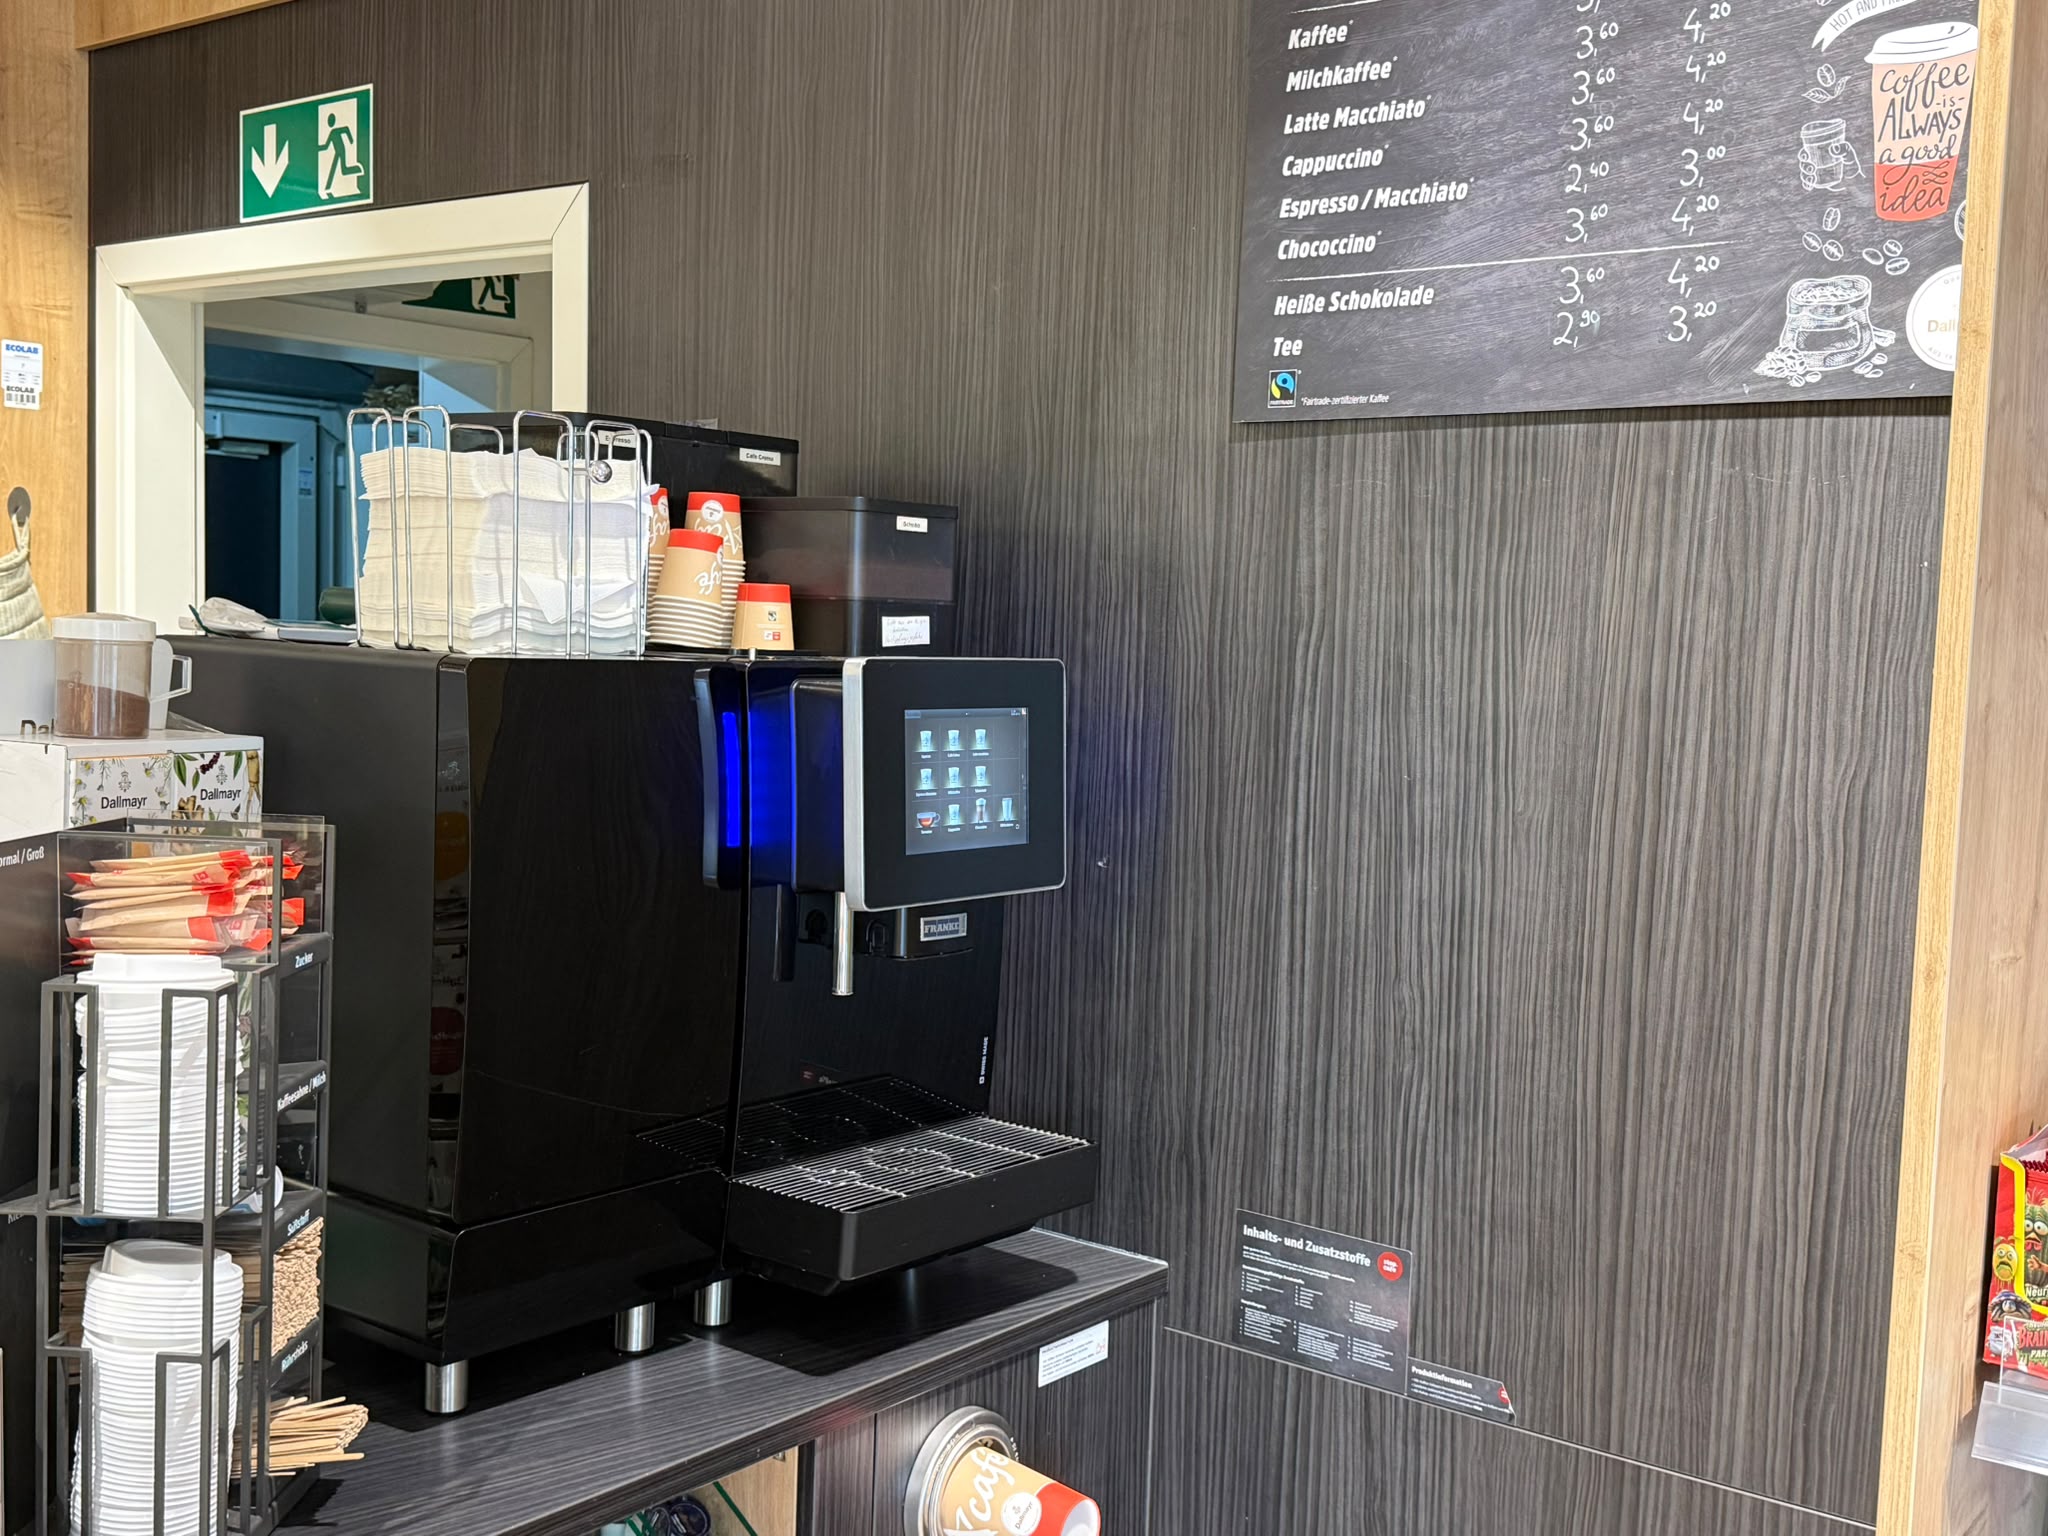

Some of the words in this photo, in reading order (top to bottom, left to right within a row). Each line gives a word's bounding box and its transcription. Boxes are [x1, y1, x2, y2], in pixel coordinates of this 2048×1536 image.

[1829, 8, 1853, 31] HOT
[1284, 112, 1329, 134] Latte
[1879, 148, 1896, 165] a
[1890, 134, 1957, 179] good
[1279, 191, 1358, 219] Espresso
[1361, 188, 1373, 211] /
[1879, 175, 1946, 214] idea
[1274, 293, 1325, 315] Heiße
[1328, 285, 1434, 312] Schokolade
[1927, 319, 1956, 333] Dall
[5, 344, 39, 354] ECOLAB
[1273, 337, 1303, 356] Tee
[6, 385, 35, 393] ECOLAB
[100, 795, 148, 810] Dallmayr
[200, 788, 241, 801] Dallmayr
[0, 849, 20, 868] ormal
[26, 846, 45, 861] Groß
[924, 921, 960, 934] FRANKE
[294, 952, 313, 968] Zucker
[1243, 1224, 1282, 1243] Inhalts-
[1284, 1236, 1304, 1250] und
[1305, 1240, 1371, 1267] Zusatzstoffe
[1015, 1502, 1033, 1529] Dallmayr
